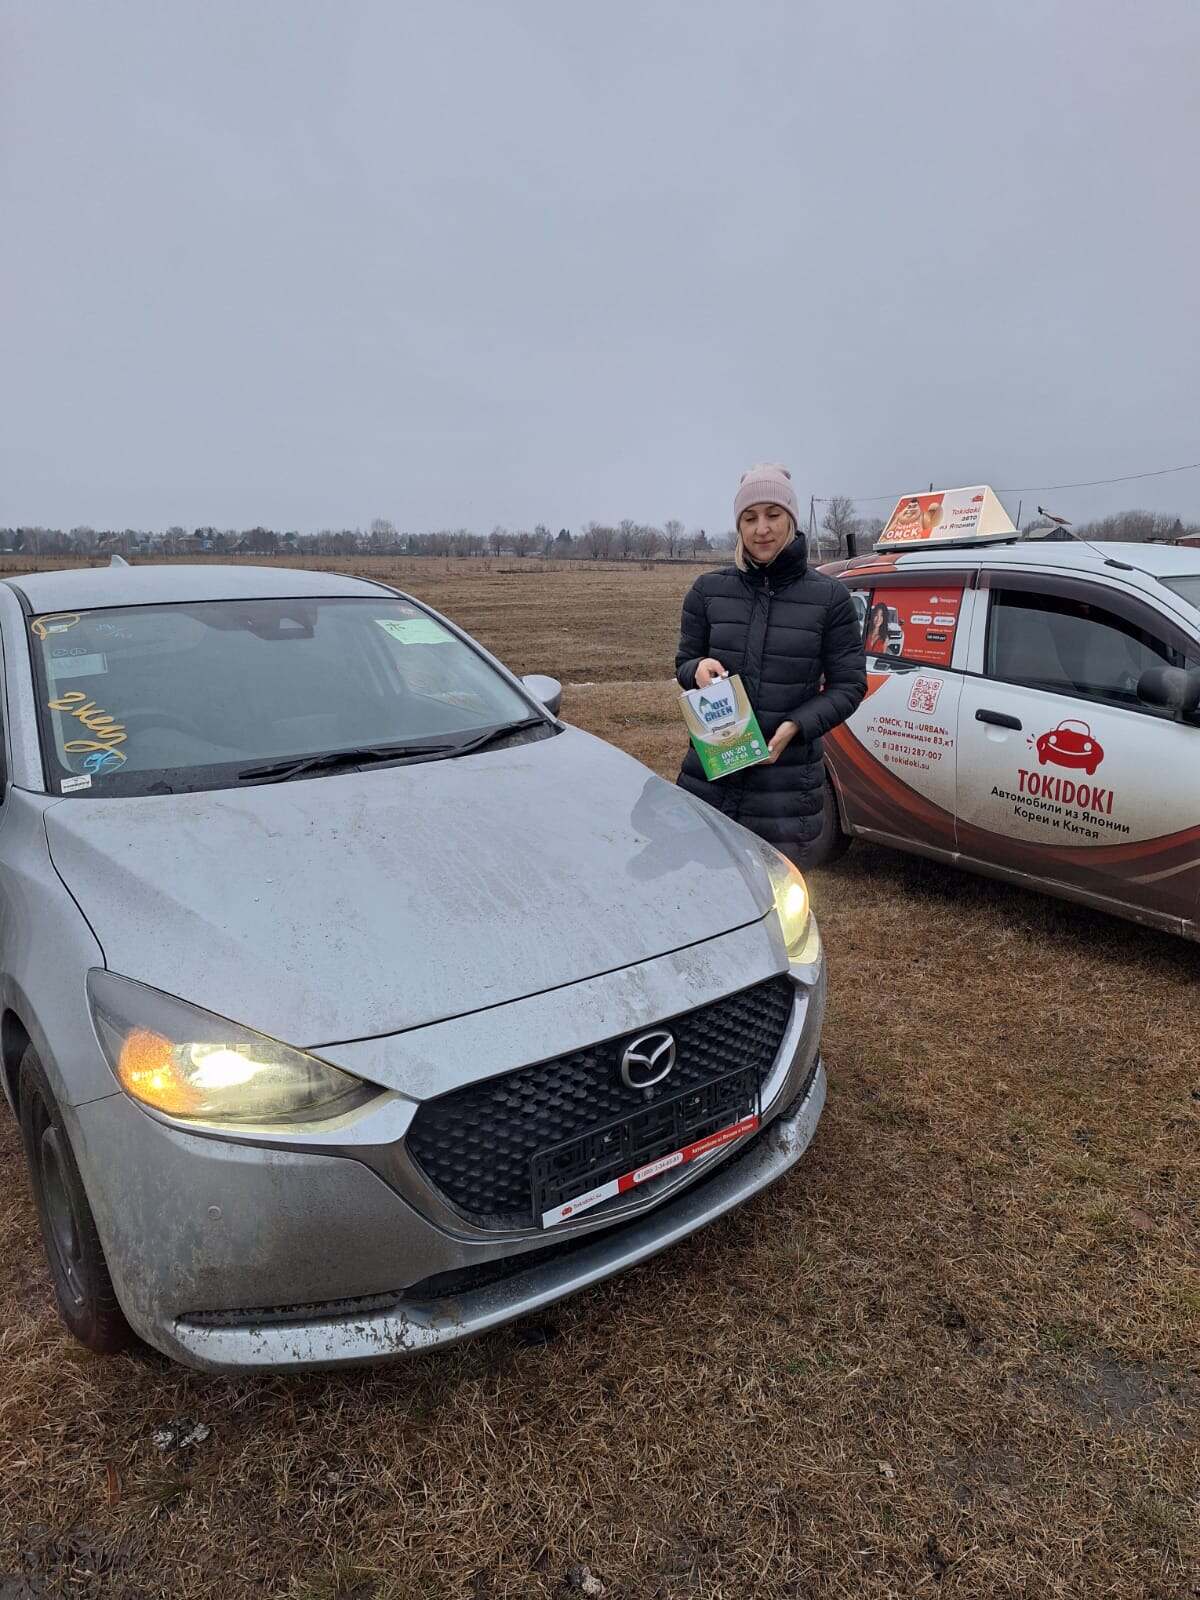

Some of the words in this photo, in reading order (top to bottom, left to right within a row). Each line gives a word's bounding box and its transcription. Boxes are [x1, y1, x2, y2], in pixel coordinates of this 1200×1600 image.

[704, 706, 733, 722] GREEN
[904, 720, 914, 731] ТЦ
[912, 747, 943, 761] 287-007
[891, 756, 930, 770] tokidoki.su
[1018, 769, 1114, 815] TOKIDOKI
[990, 786, 1062, 815] Автомобили
[1065, 808, 1079, 819] из
[1081, 811, 1131, 834] Японии
[1052, 818, 1060, 828] и
[1062, 820, 1100, 840] Китая
